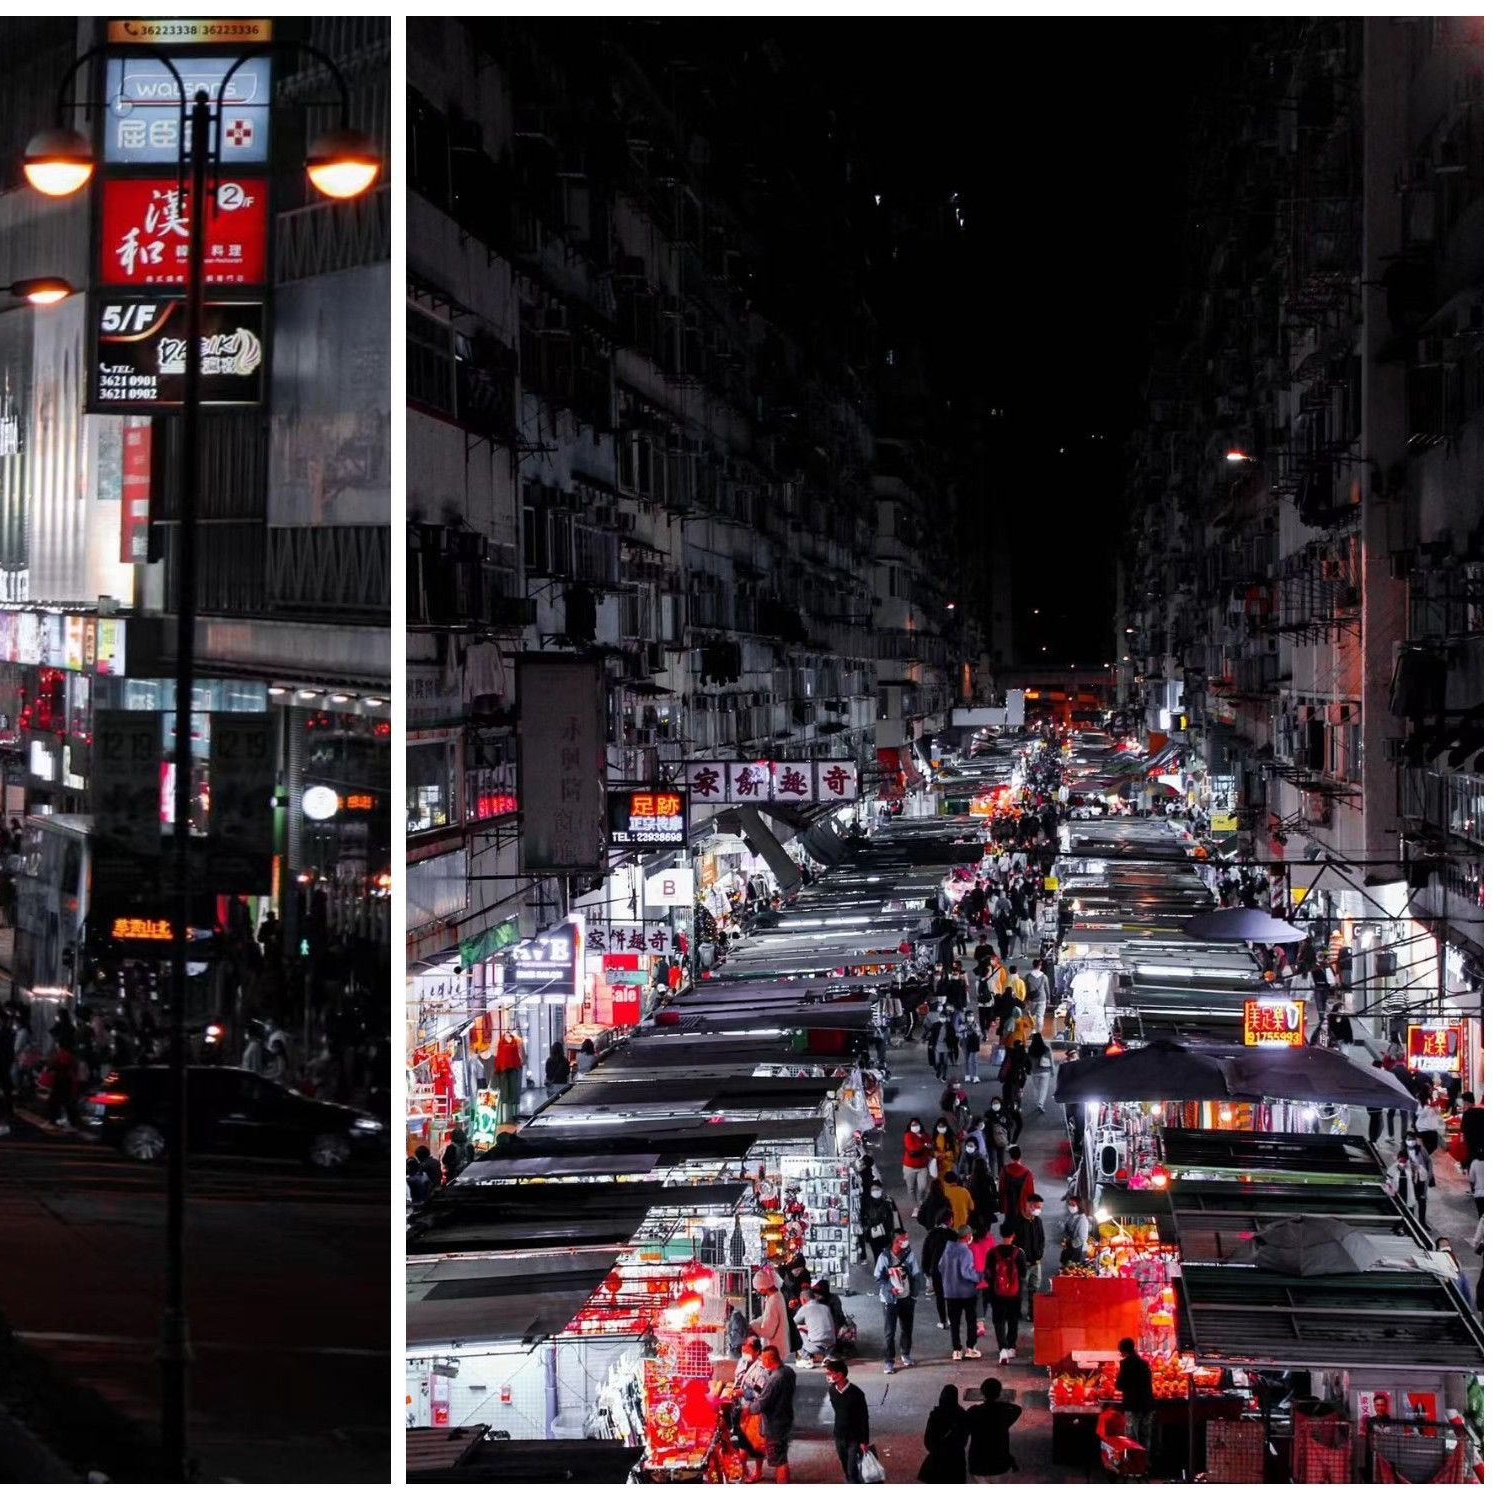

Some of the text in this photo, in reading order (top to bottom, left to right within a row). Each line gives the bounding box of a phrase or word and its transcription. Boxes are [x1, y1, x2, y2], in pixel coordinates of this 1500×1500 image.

[140, 23, 259, 36] 36223338 36223336
[118, 118, 198, 150] 屈臣
[102, 305, 157, 332] 5/F
[100, 376, 126, 386] 3621
[100, 389, 126, 399] 3621
[633, 795, 680, 816] 足跡
[663, 880, 676, 895] B
